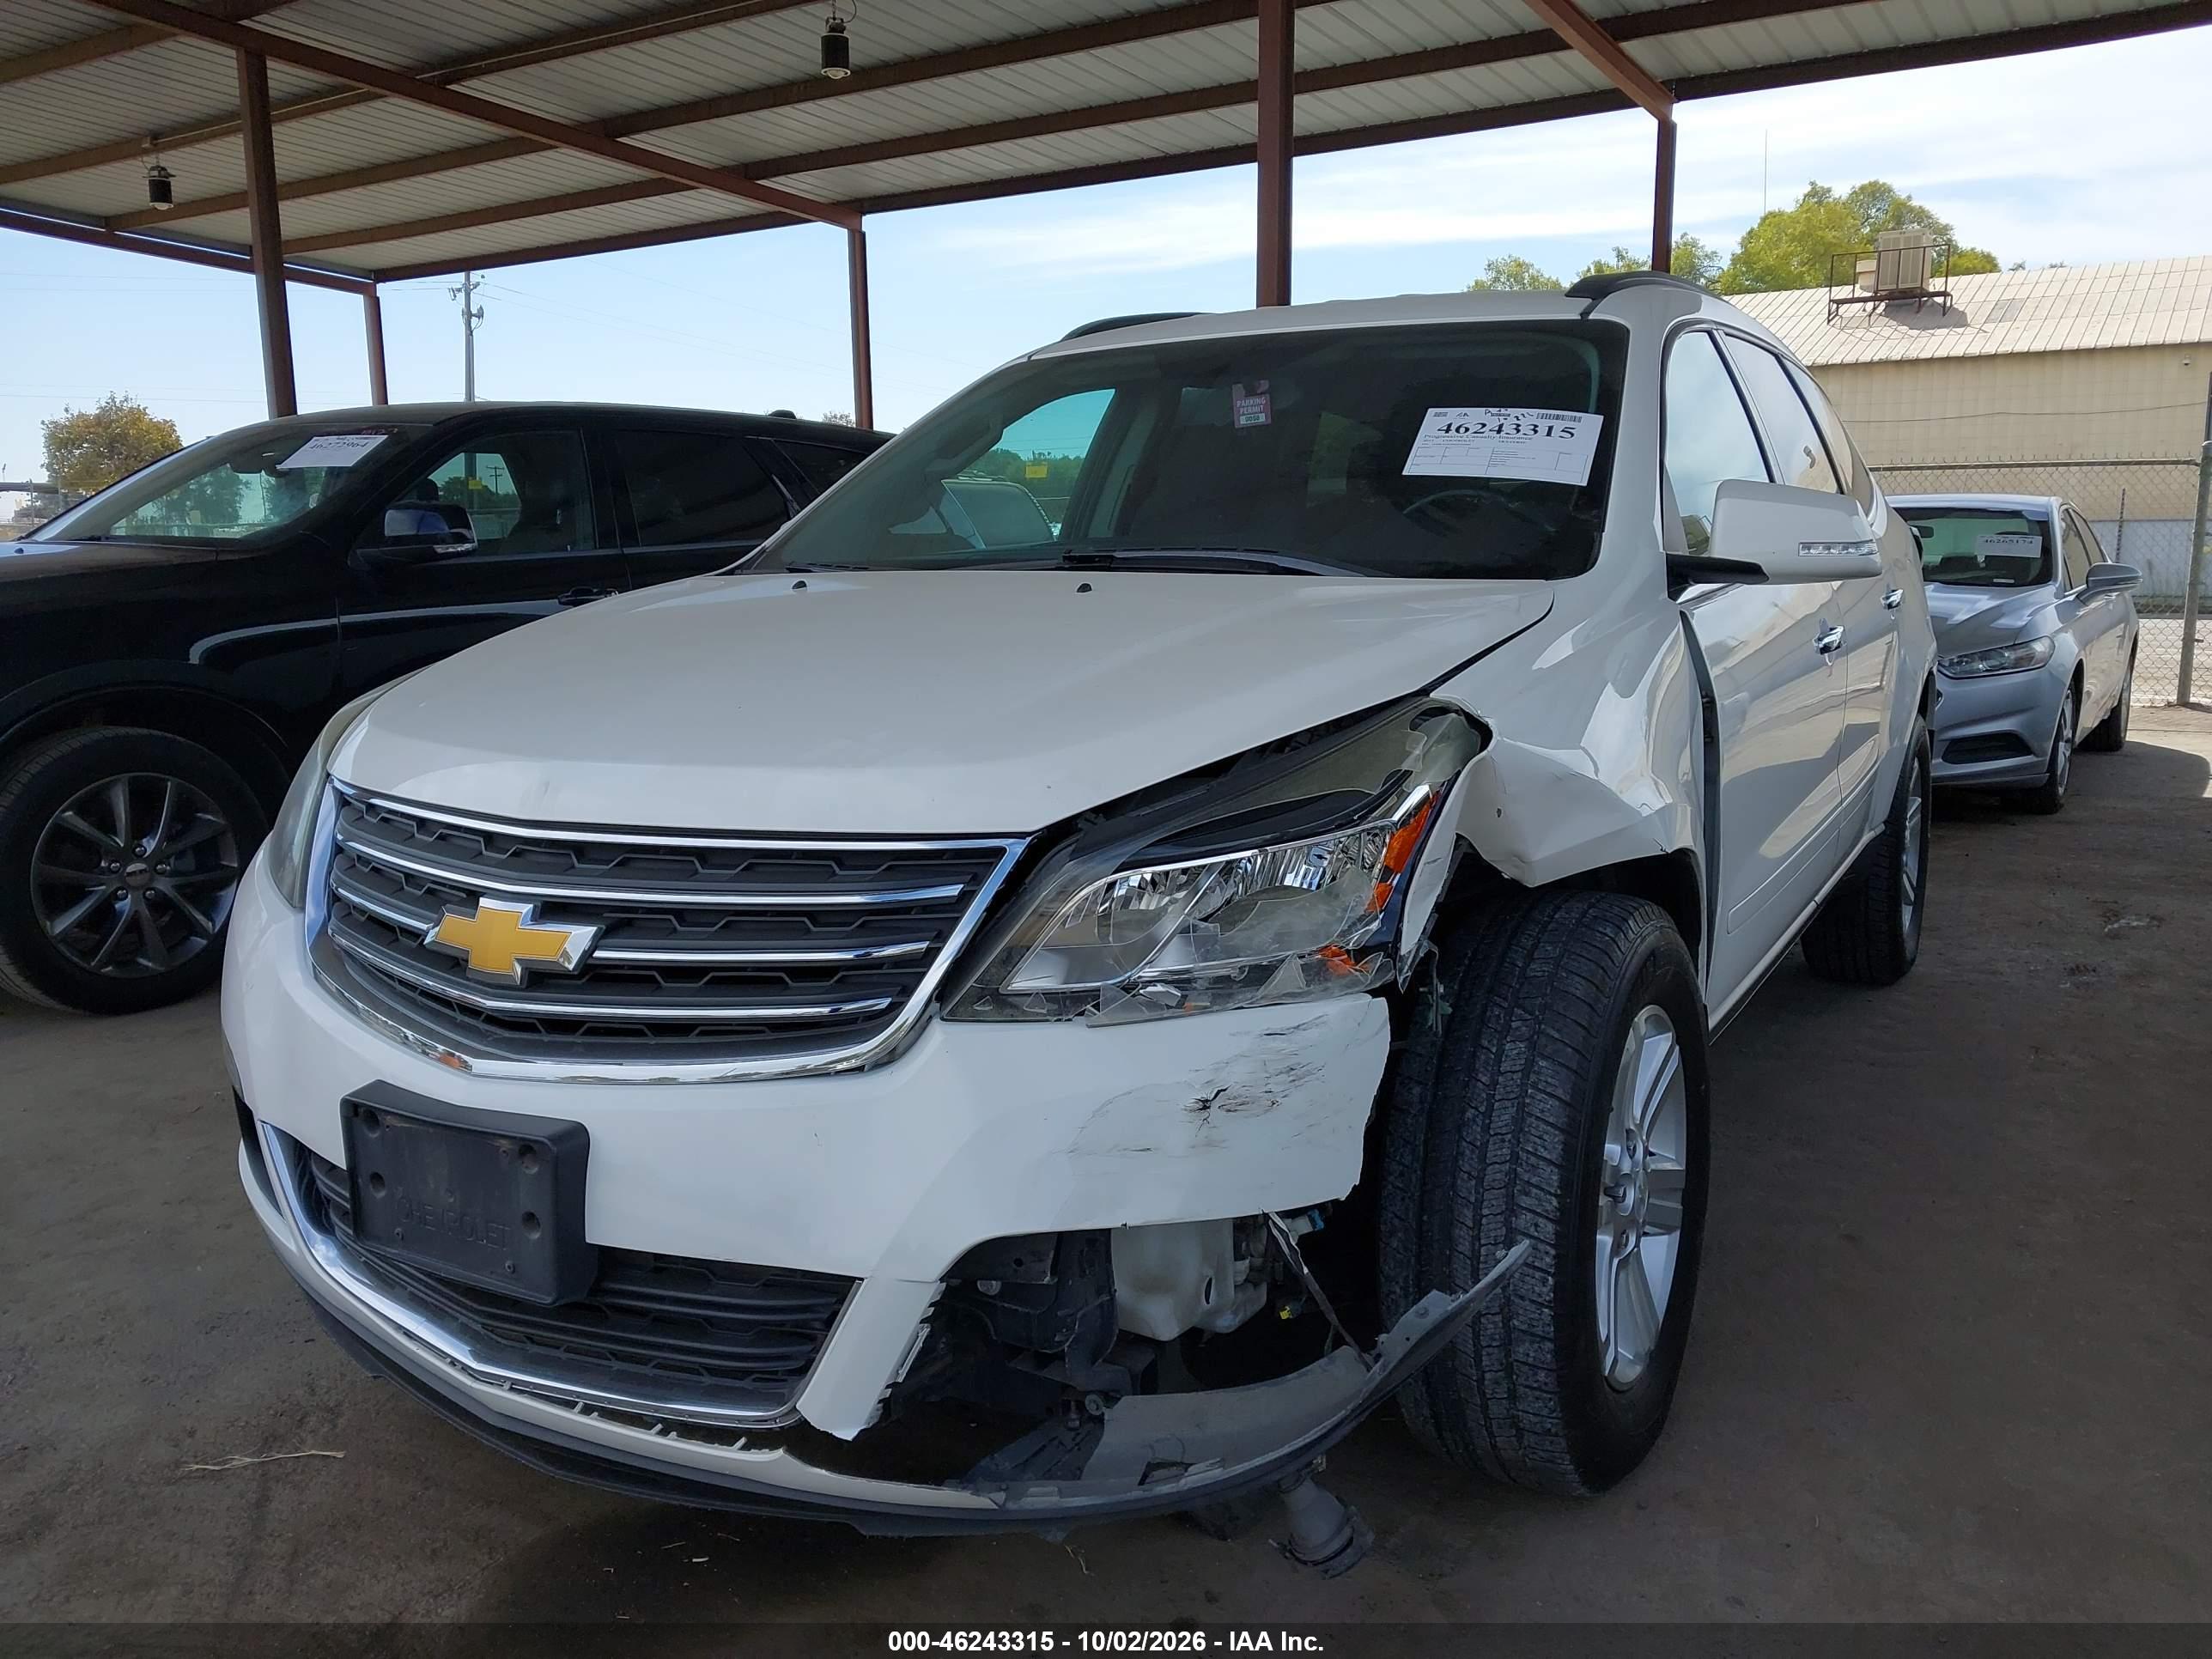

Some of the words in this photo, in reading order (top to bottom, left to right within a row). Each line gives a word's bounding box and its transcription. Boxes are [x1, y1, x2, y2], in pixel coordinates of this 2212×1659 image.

[1237, 397, 1266, 407] PARKING
[1240, 404, 1264, 415] PERMIT
[1437, 422, 1578, 440] 46243315
